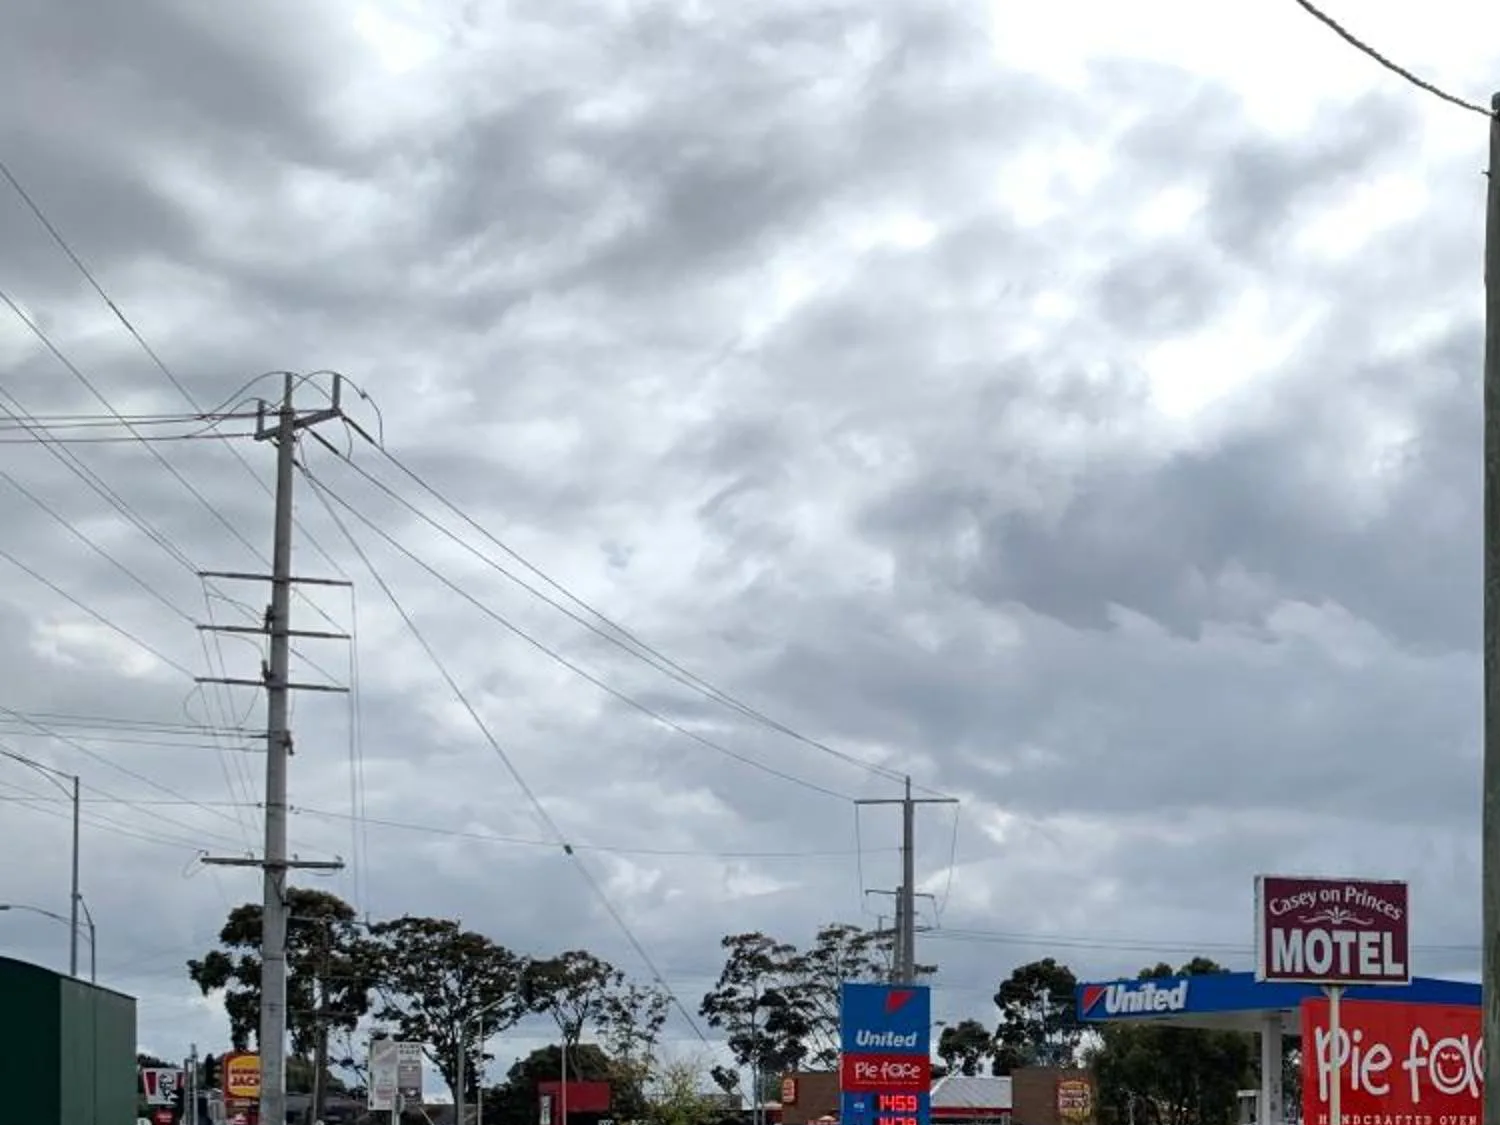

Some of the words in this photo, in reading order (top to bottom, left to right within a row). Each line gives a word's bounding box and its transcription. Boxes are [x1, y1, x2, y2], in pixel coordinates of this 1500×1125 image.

[1269, 890, 1317, 916] Casey
[1320, 888, 1341, 903] on
[1345, 886, 1404, 920] Princes
[1271, 927, 1405, 976] MOTEL
[1105, 980, 1189, 1014] United
[856, 1029, 918, 1048] United
[855, 1061, 878, 1080] Pie
[880, 1061, 922, 1080] face
[1315, 1026, 1393, 1102] Pie
